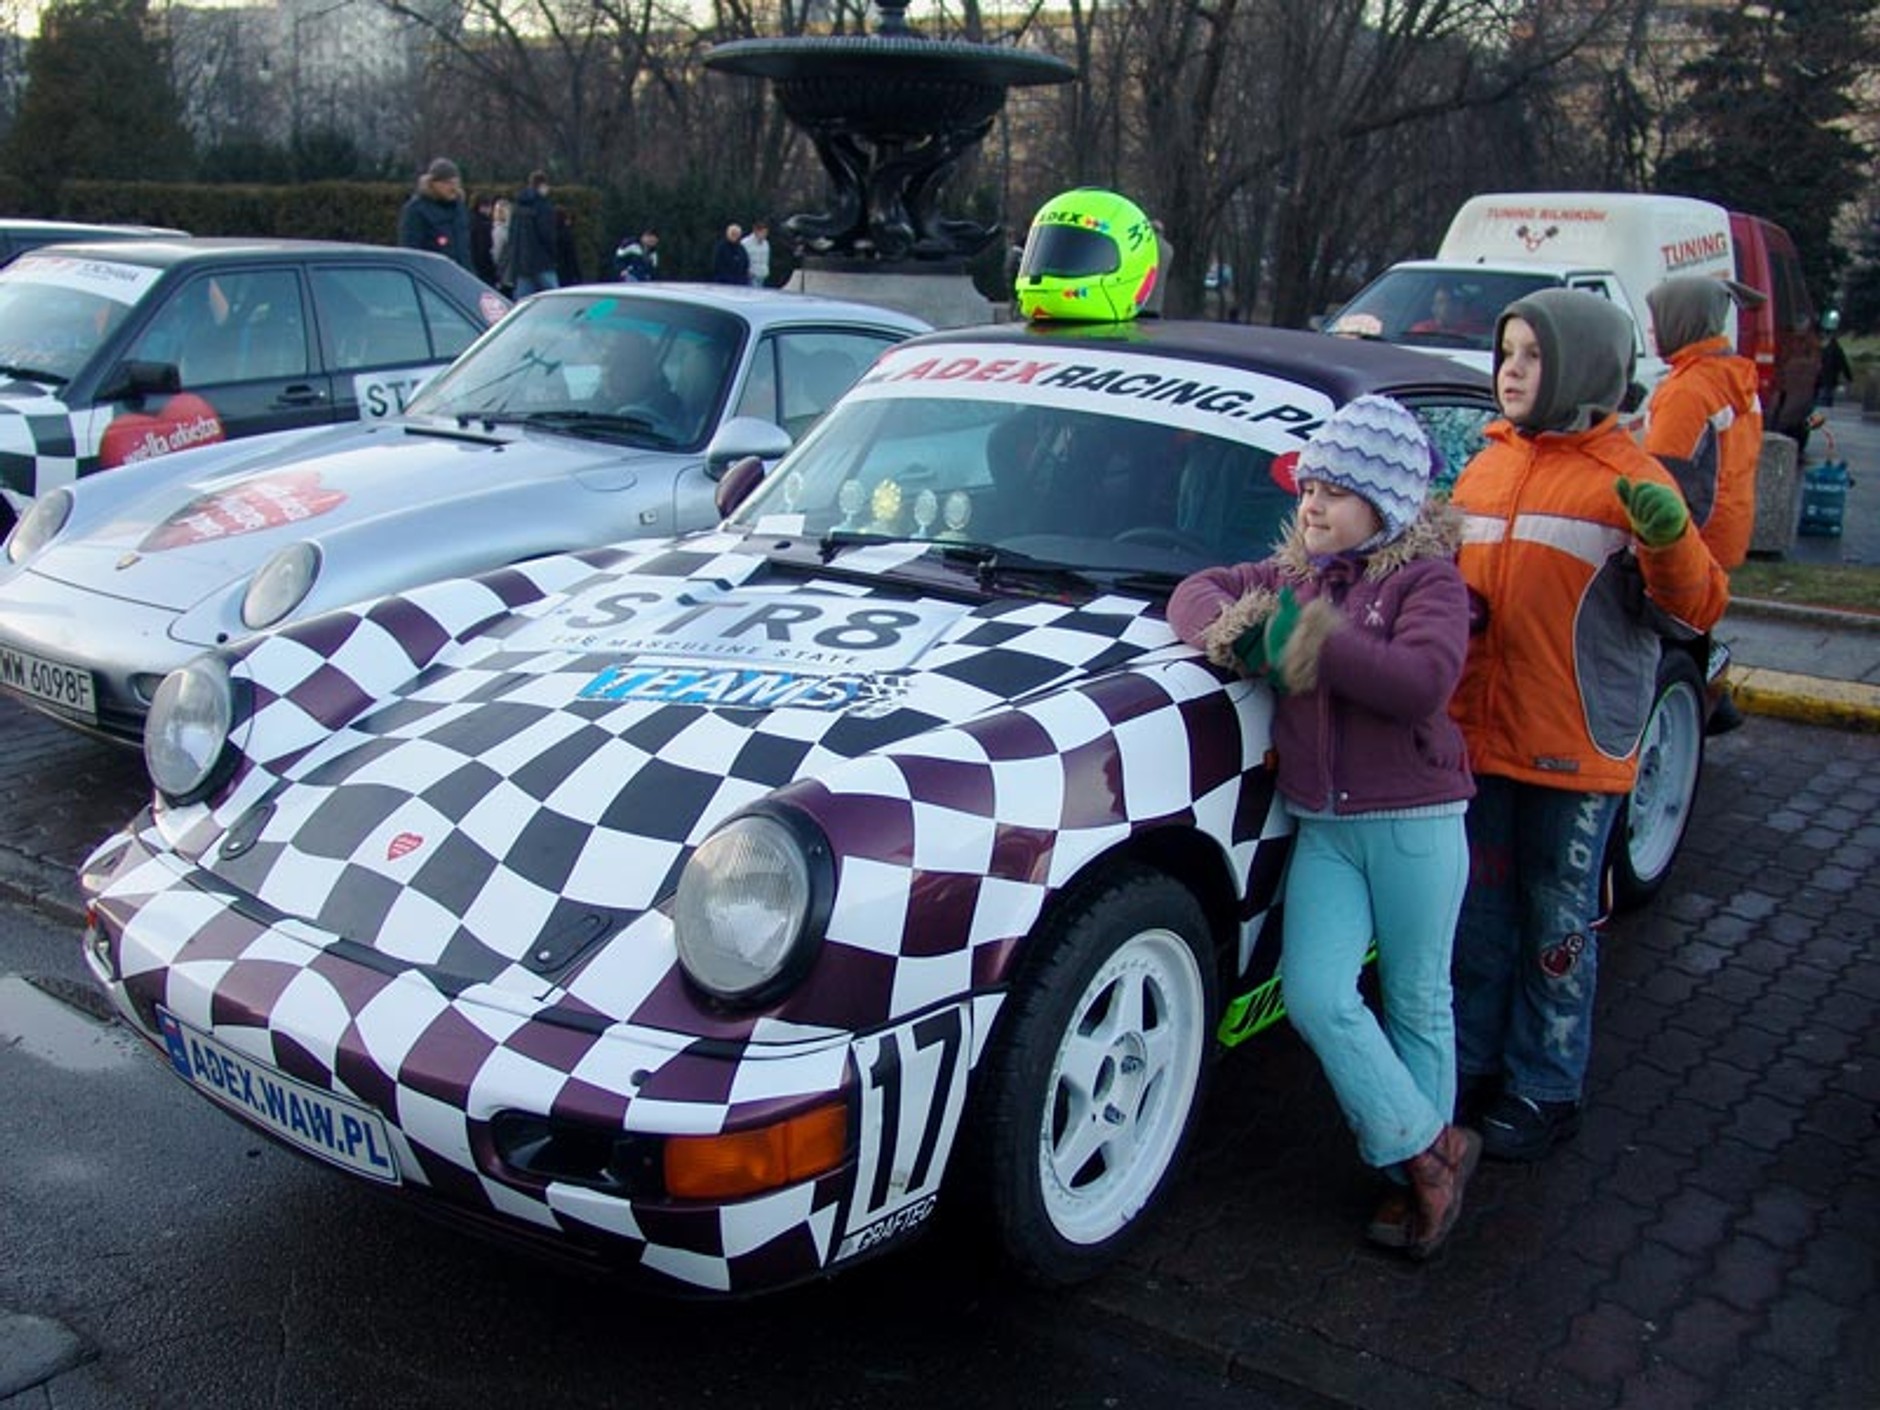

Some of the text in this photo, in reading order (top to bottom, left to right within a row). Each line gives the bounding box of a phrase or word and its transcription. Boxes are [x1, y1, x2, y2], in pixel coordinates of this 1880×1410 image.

[1661, 231, 1727, 266] TUNING
[366, 379, 422, 417] ST
[564, 591, 922, 651] STR8
[606, 637, 762, 655] MASCULINE
[773, 648, 861, 665] STATE
[31, 661, 90, 707] 6098F
[191, 1039, 390, 1168] ADEX.WAW.PL
[870, 1005, 963, 1215] 17
